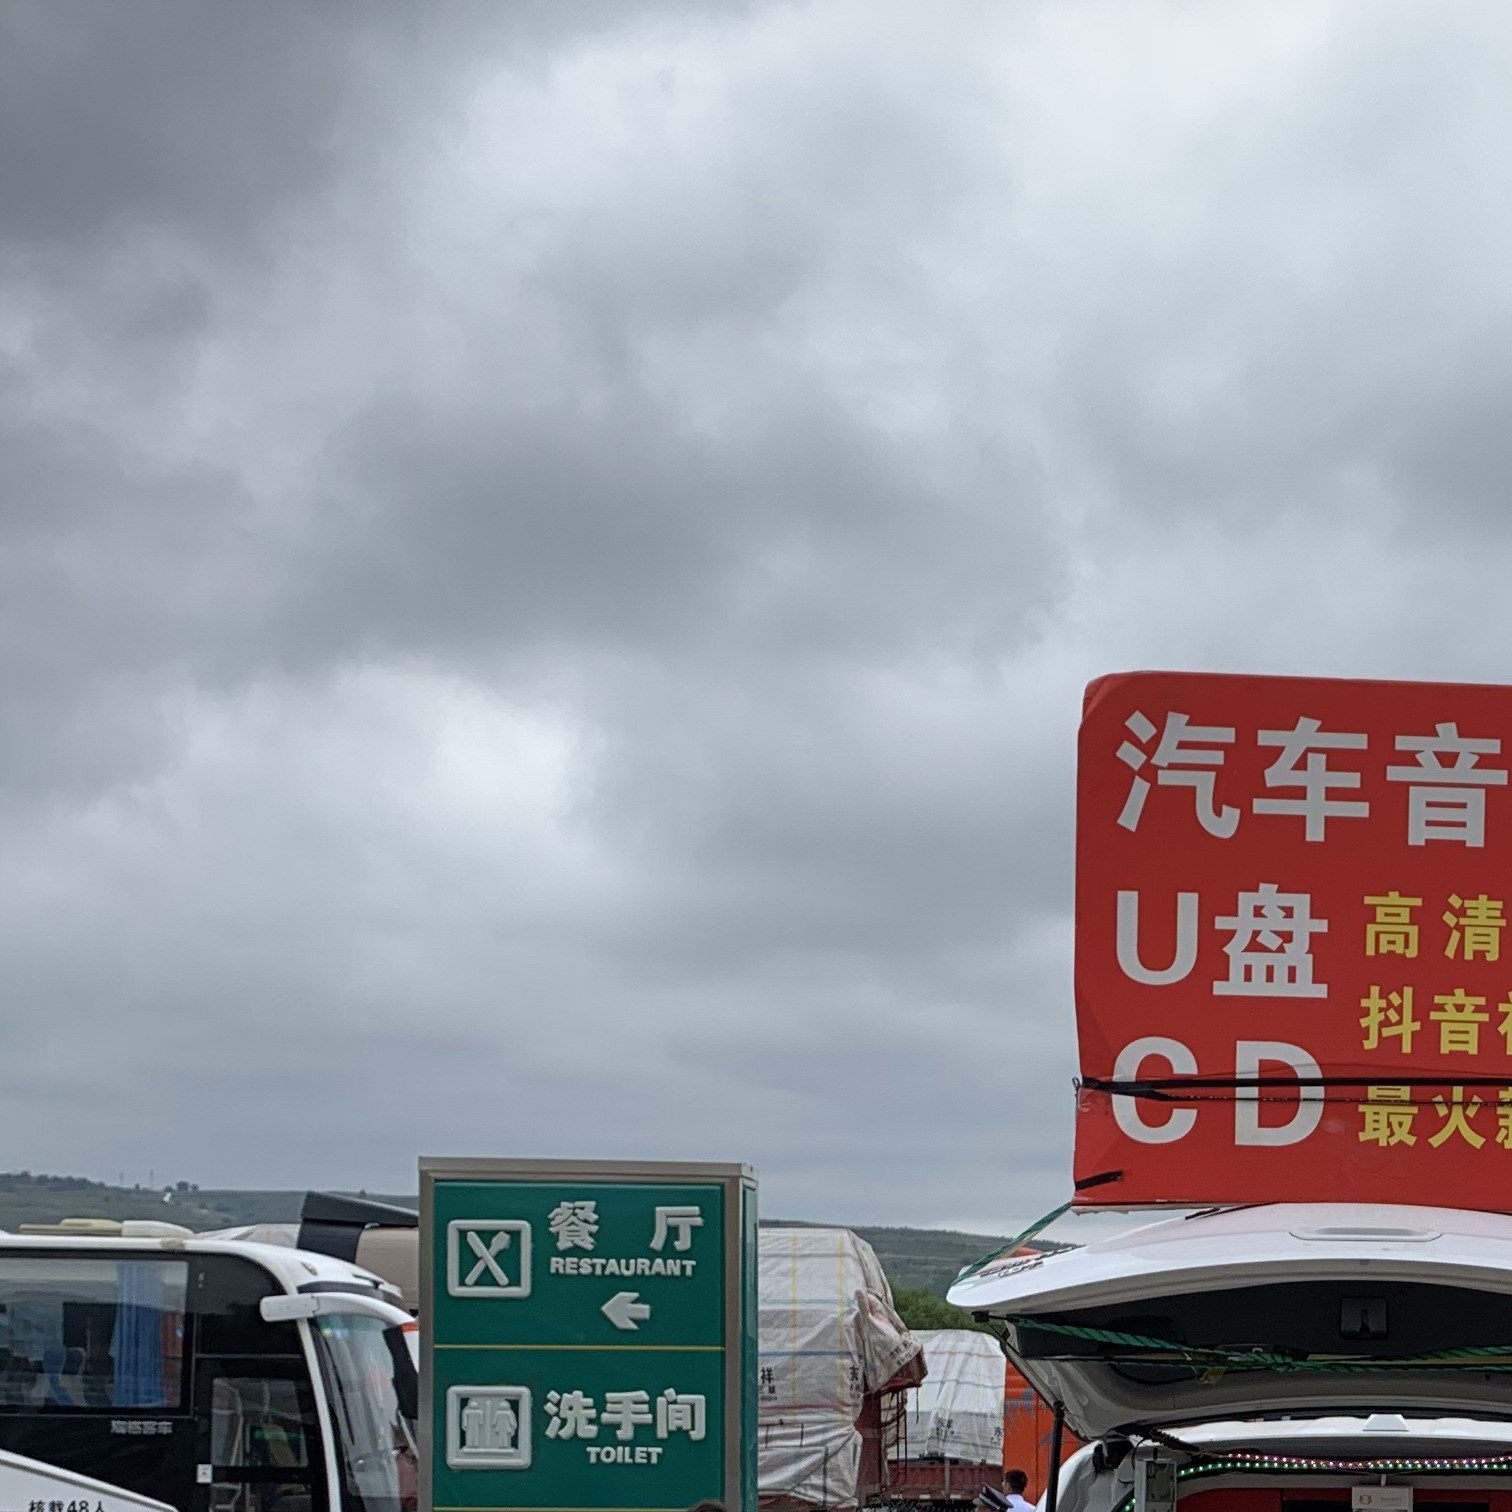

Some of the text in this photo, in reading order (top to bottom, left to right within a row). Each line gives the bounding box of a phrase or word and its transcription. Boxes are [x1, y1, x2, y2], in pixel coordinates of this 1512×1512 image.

[1115, 882, 1329, 999] U盘
[1111, 1036, 1325, 1147] CD
[547, 1199, 704, 1252] 餐厅
[549, 1257, 697, 1277] RESTAURANT
[543, 1387, 707, 1442] 洗手间
[586, 1445, 663, 1465] TOILET
